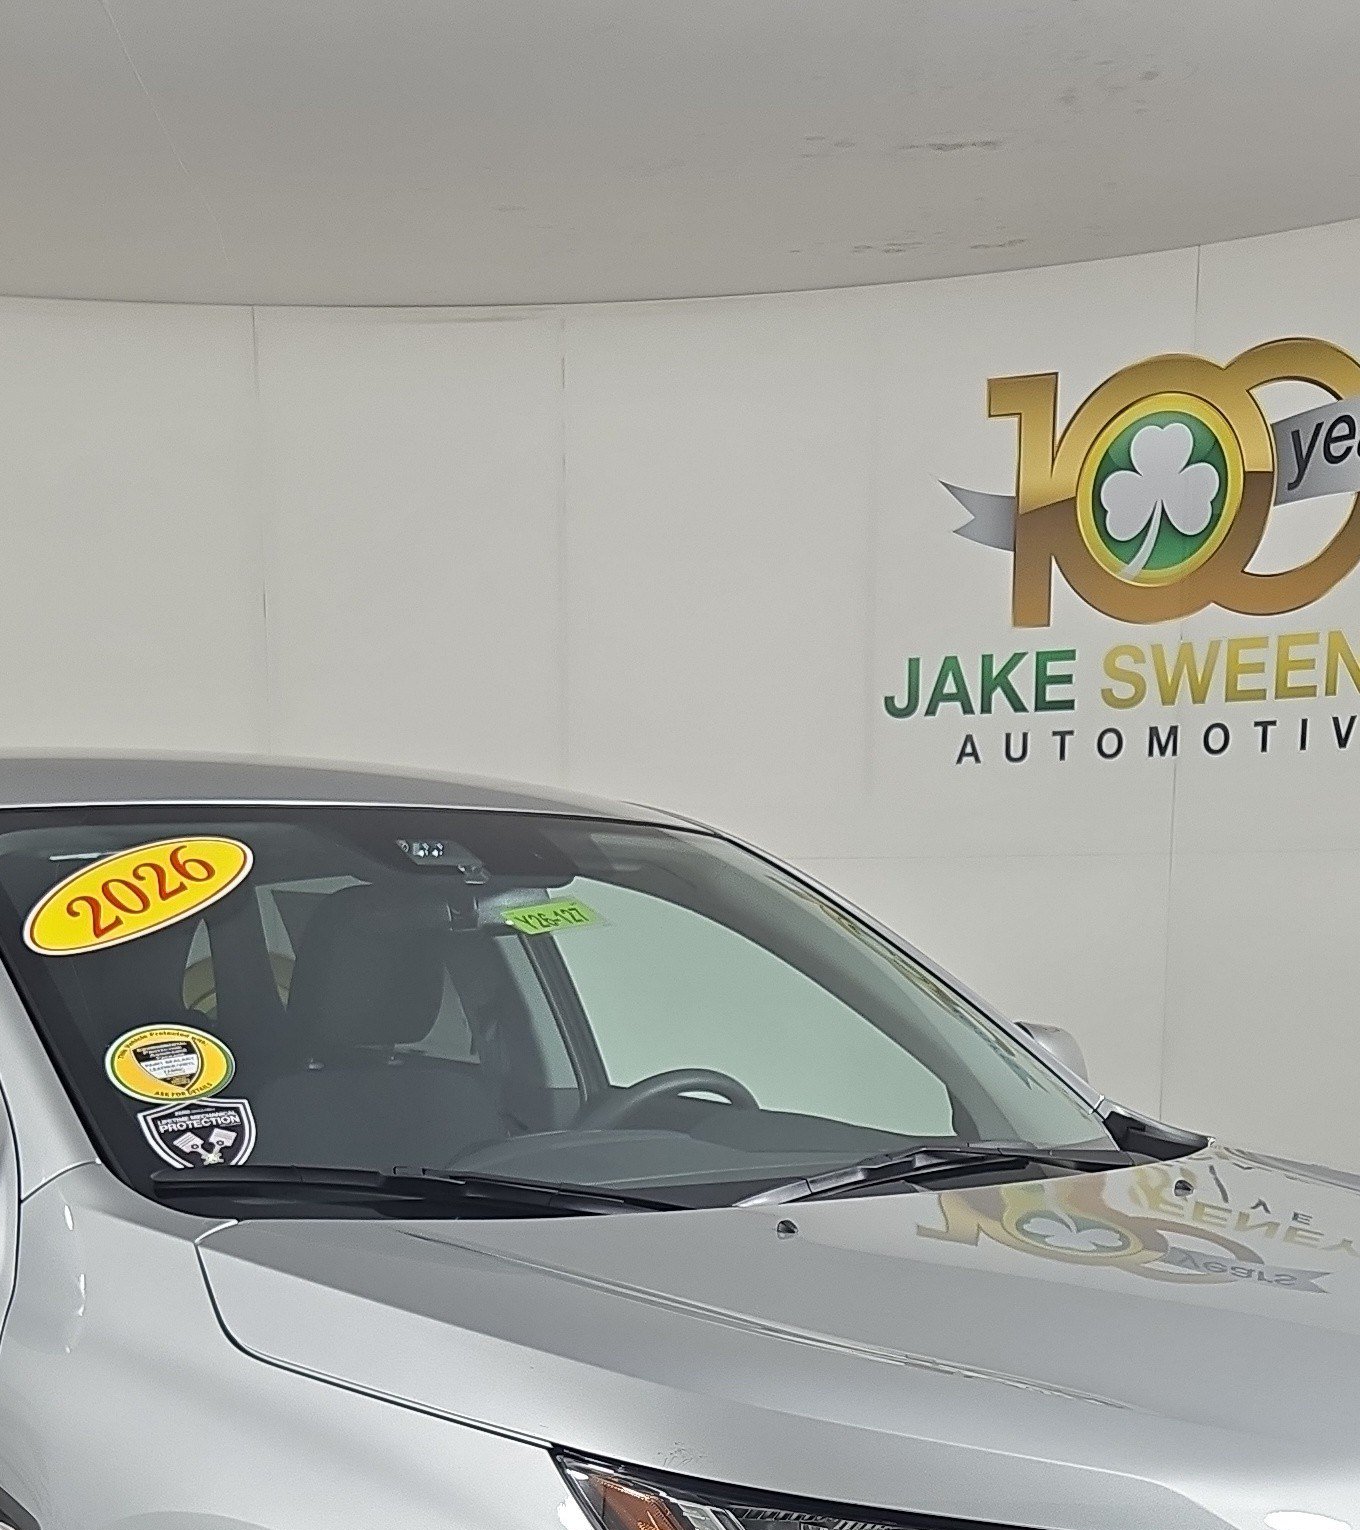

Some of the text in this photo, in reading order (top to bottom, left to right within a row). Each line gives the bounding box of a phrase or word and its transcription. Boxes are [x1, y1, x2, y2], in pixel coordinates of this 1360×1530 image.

[883, 648, 1077, 720] JAKE
[66, 845, 216, 939] 2026
[158, 1115, 240, 1133] PROTECTION
